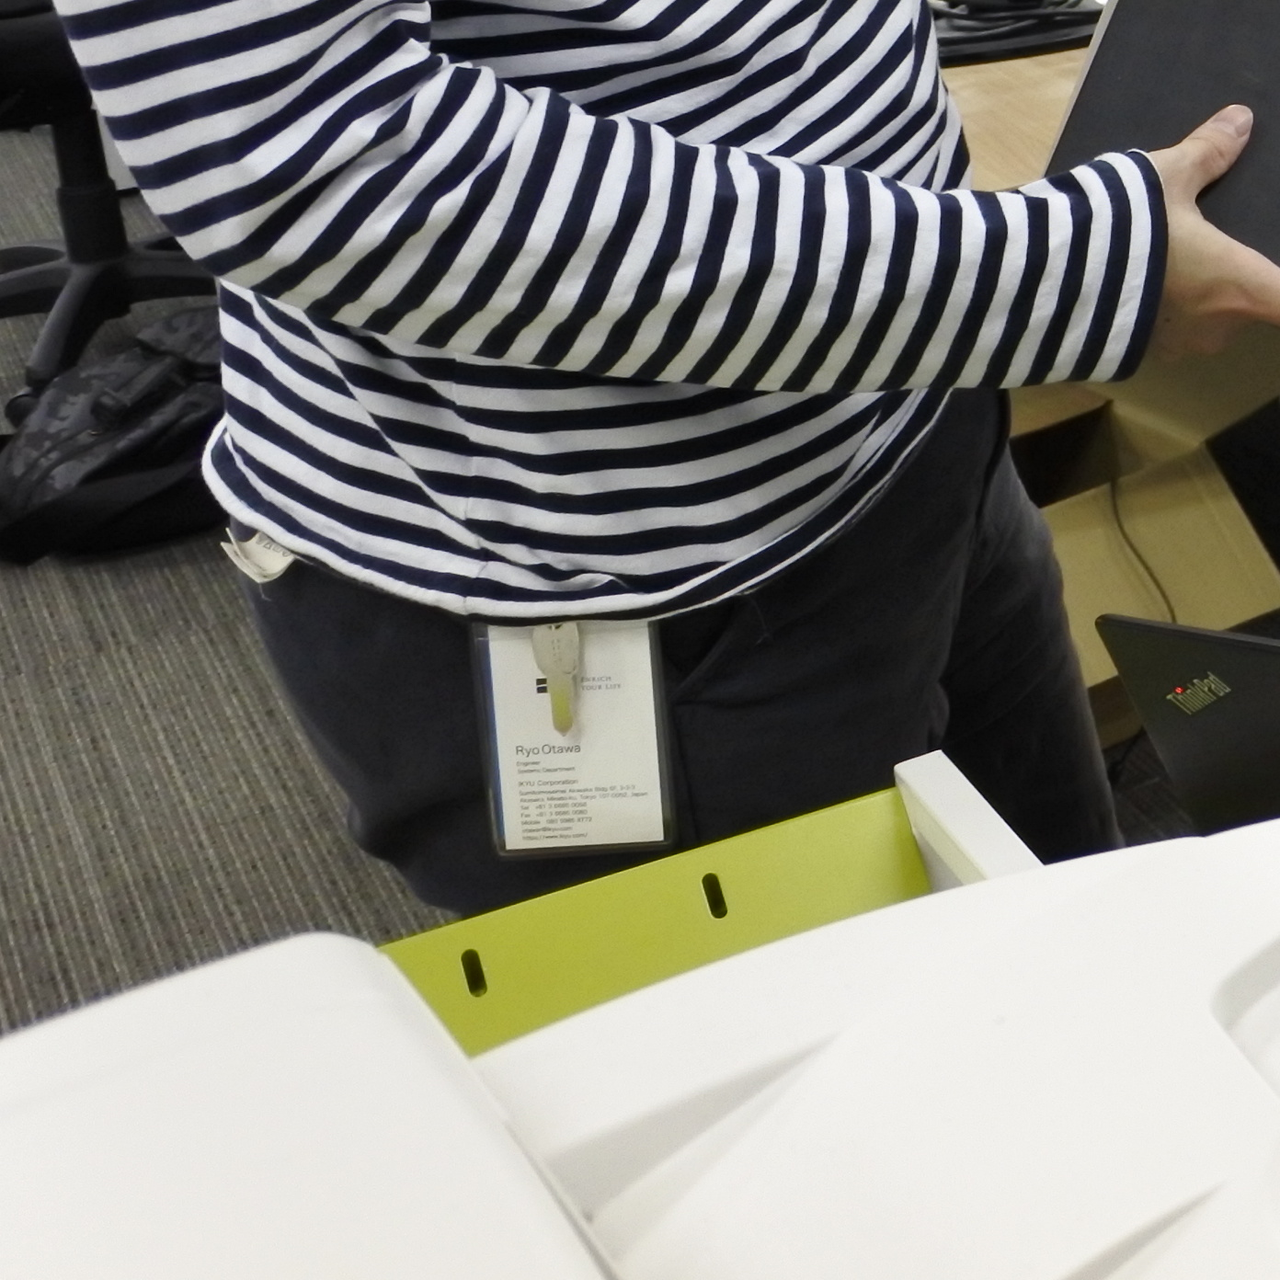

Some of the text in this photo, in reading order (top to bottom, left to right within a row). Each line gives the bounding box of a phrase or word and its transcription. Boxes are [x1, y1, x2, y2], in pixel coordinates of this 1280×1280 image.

[1166, 670, 1232, 717] ThinkPad
[515, 743, 581, 758] Ryo Otawa
[537, 778, 579, 788] Corporation
